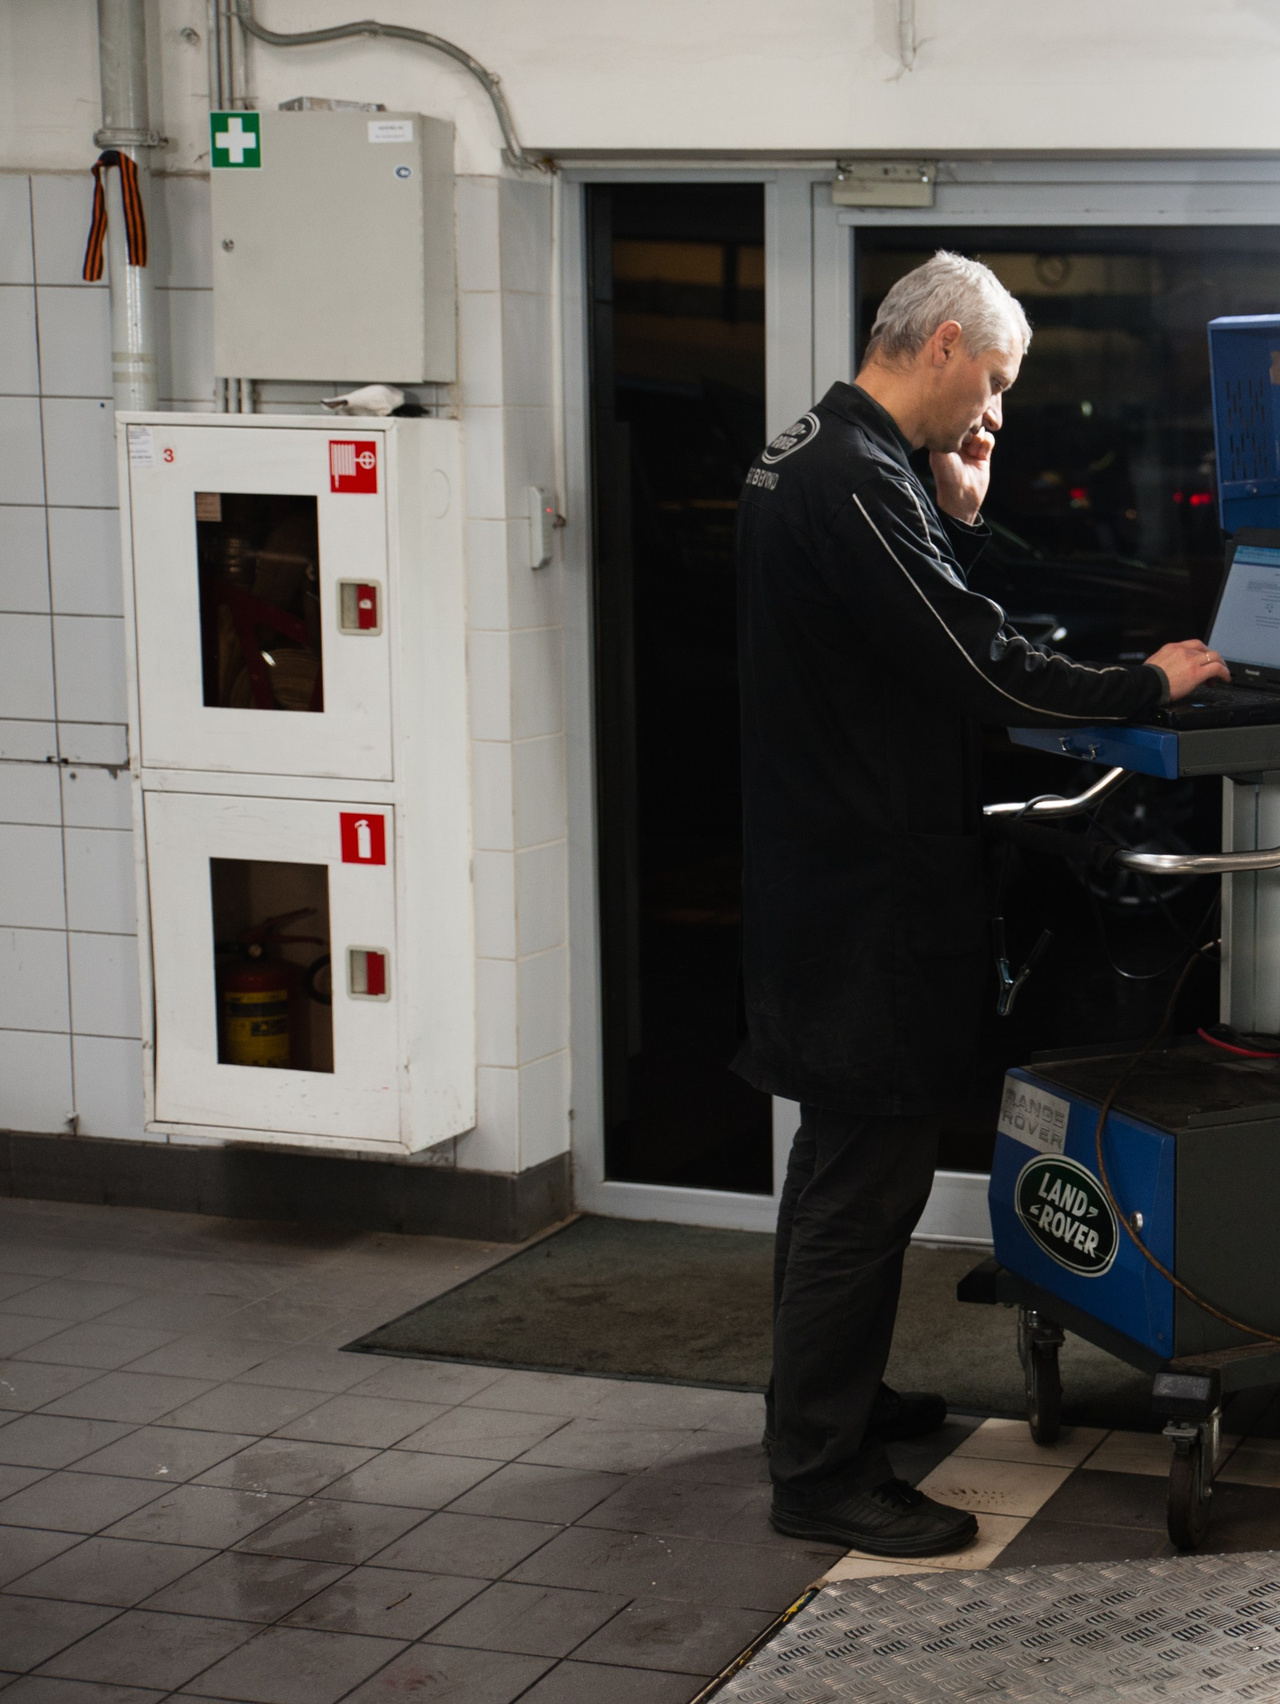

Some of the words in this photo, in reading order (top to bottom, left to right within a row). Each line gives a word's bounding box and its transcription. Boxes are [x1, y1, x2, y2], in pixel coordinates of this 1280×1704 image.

[163, 448, 174, 463] 3
[1005, 1087, 1066, 1129] RANGE
[1002, 1109, 1063, 1150] ROVER
[1038, 1171, 1089, 1218] LAND
[1038, 1204, 1100, 1259] ROVER
